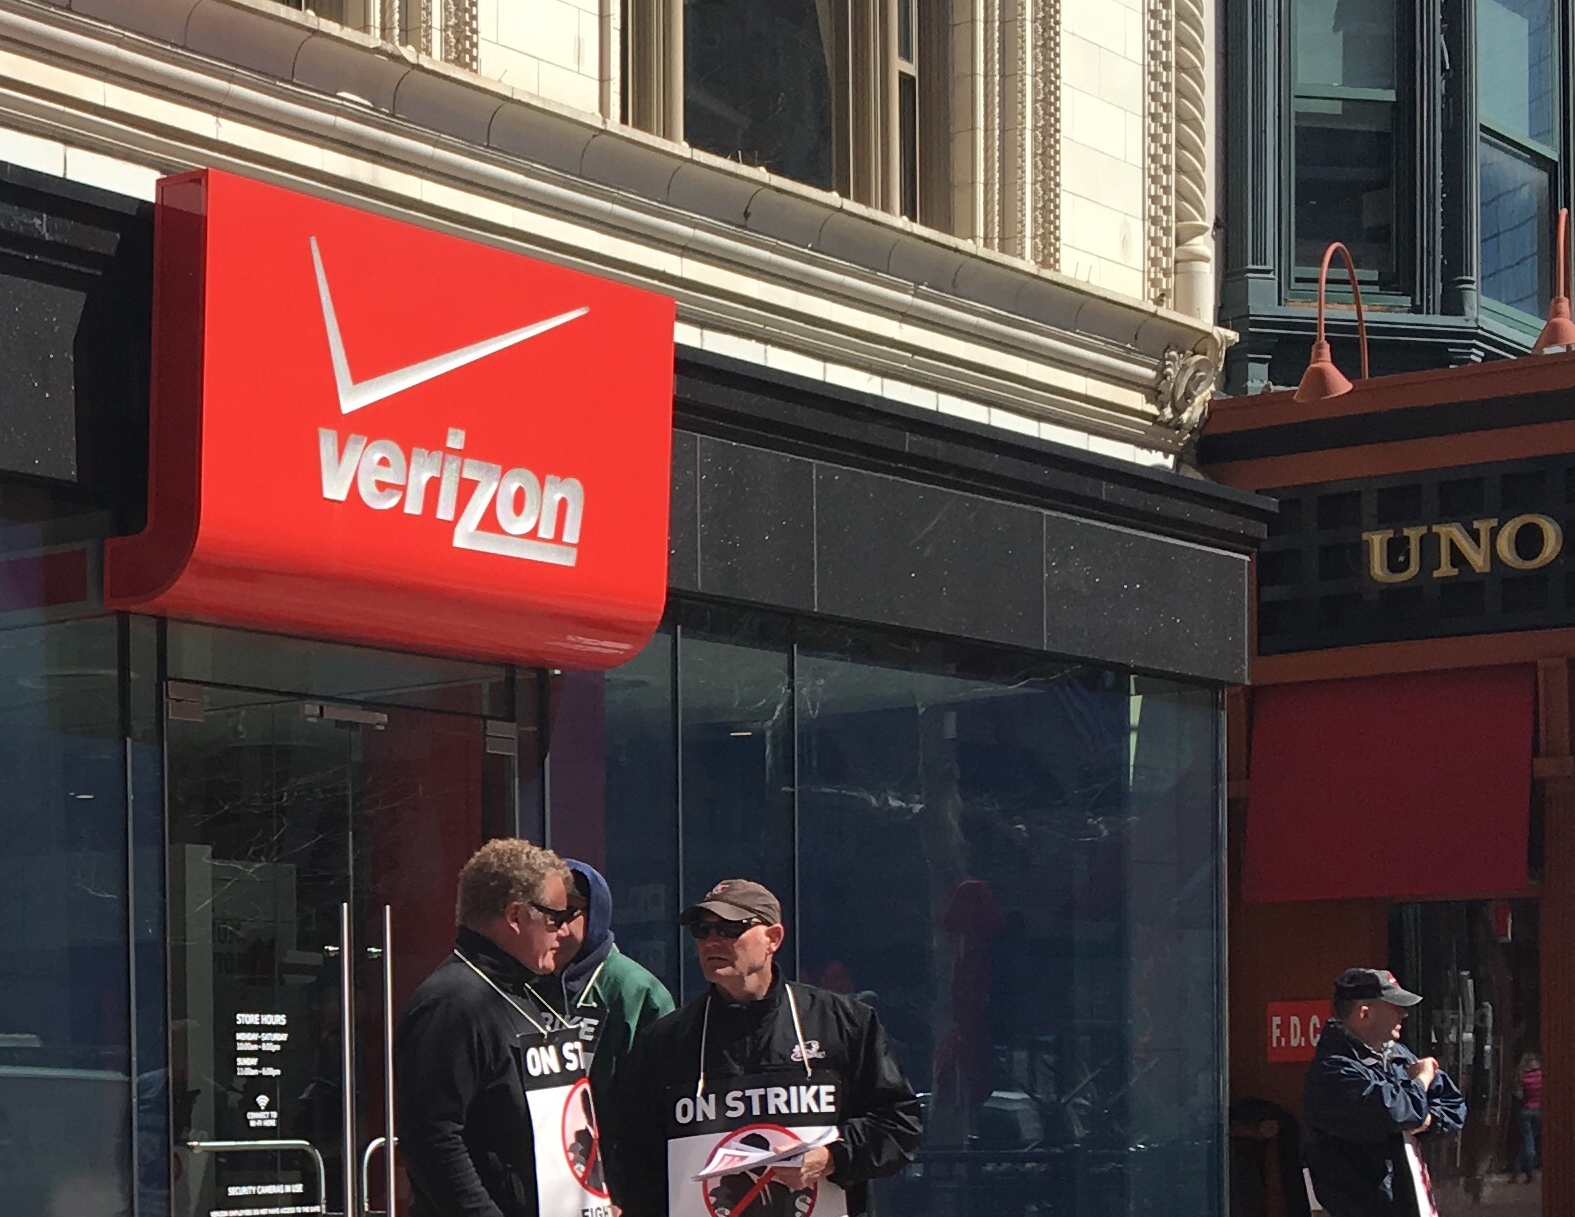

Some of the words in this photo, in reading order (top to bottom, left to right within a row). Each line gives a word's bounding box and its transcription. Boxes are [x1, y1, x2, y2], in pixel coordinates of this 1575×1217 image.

[318, 426, 585, 567] verizon
[1361, 513, 1564, 583] UNO
[236, 1013, 260, 1025] STORE
[260, 1014, 287, 1026] HOURS
[526, 1045, 561, 1076] ON
[675, 1093, 716, 1124] ON
[724, 1084, 837, 1118] STRIKE
